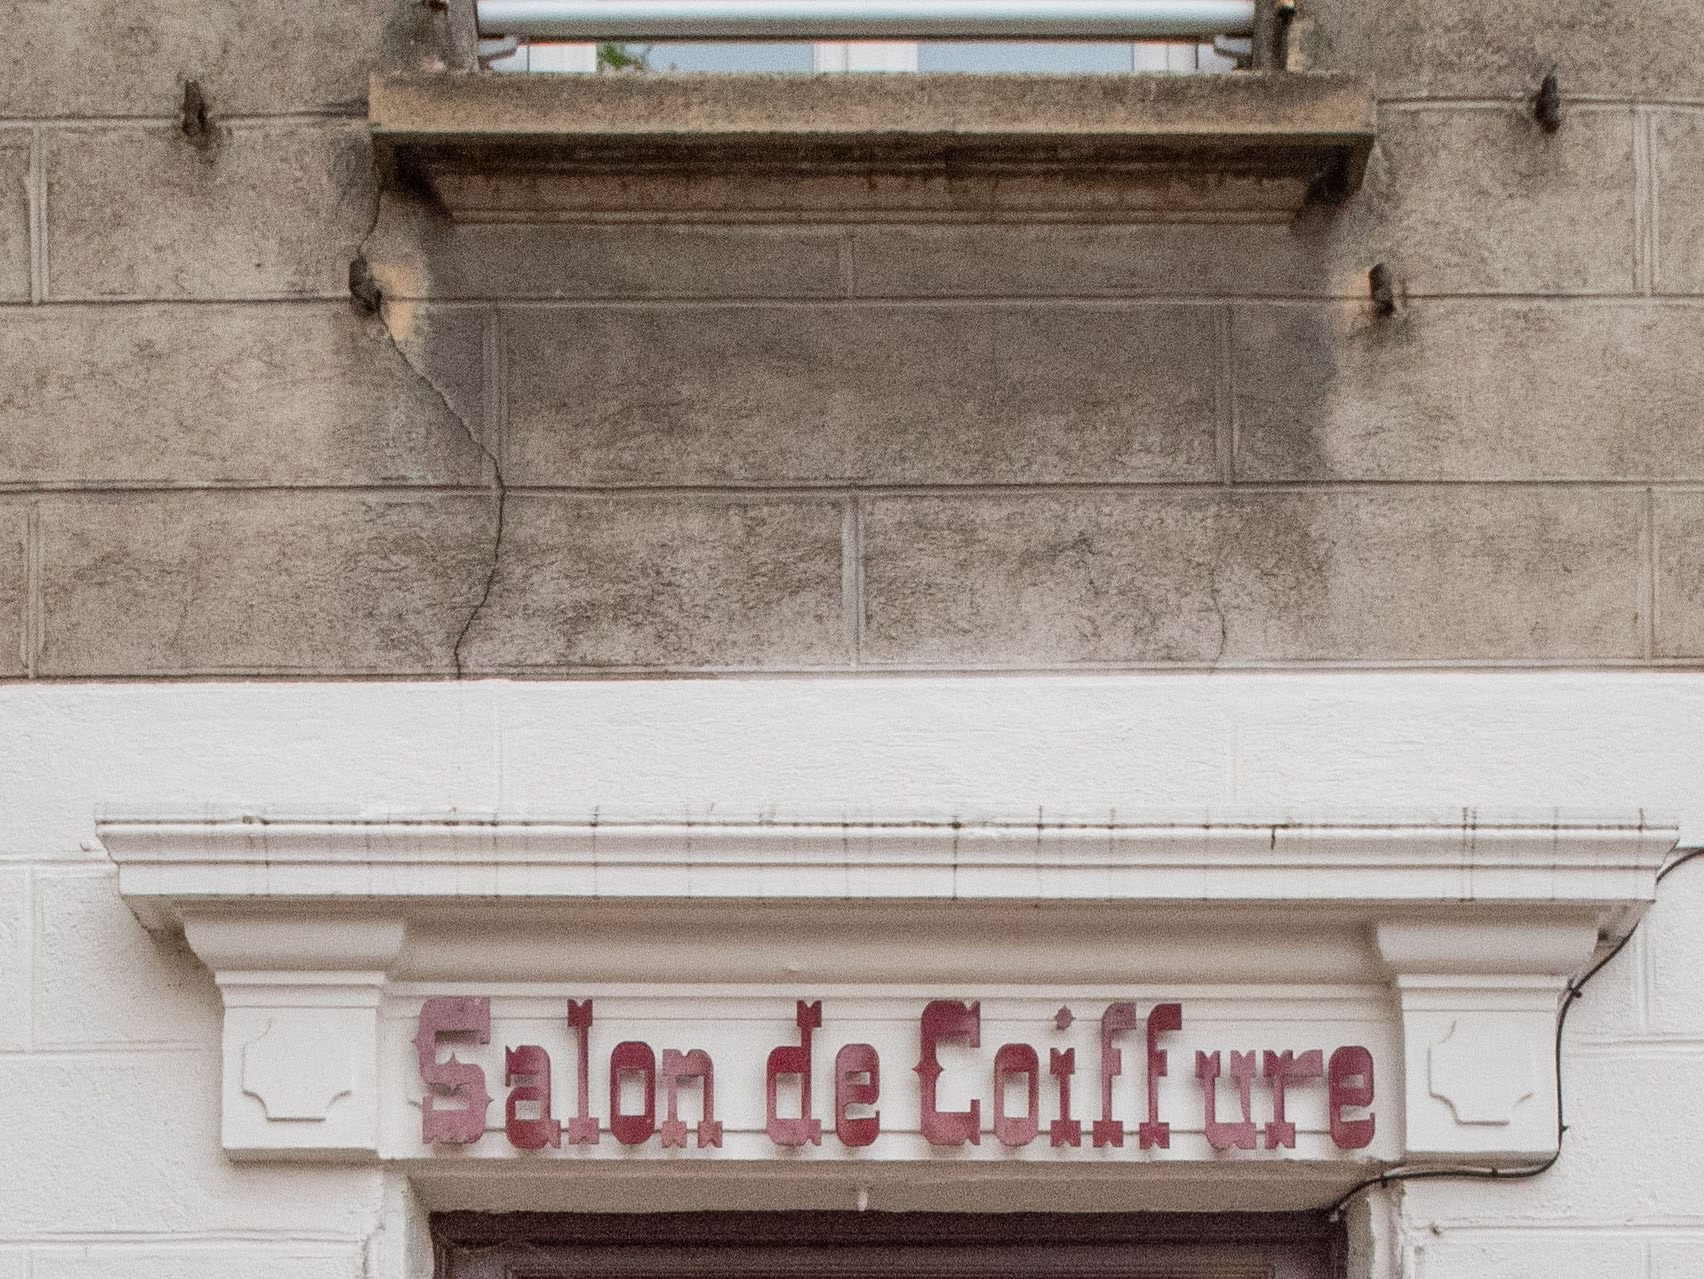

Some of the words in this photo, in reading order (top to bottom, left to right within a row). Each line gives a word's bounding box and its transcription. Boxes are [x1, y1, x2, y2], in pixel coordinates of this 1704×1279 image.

[409, 996, 724, 1150] Salon
[766, 998, 881, 1148] de
[911, 998, 1377, 1151] Coiffure
